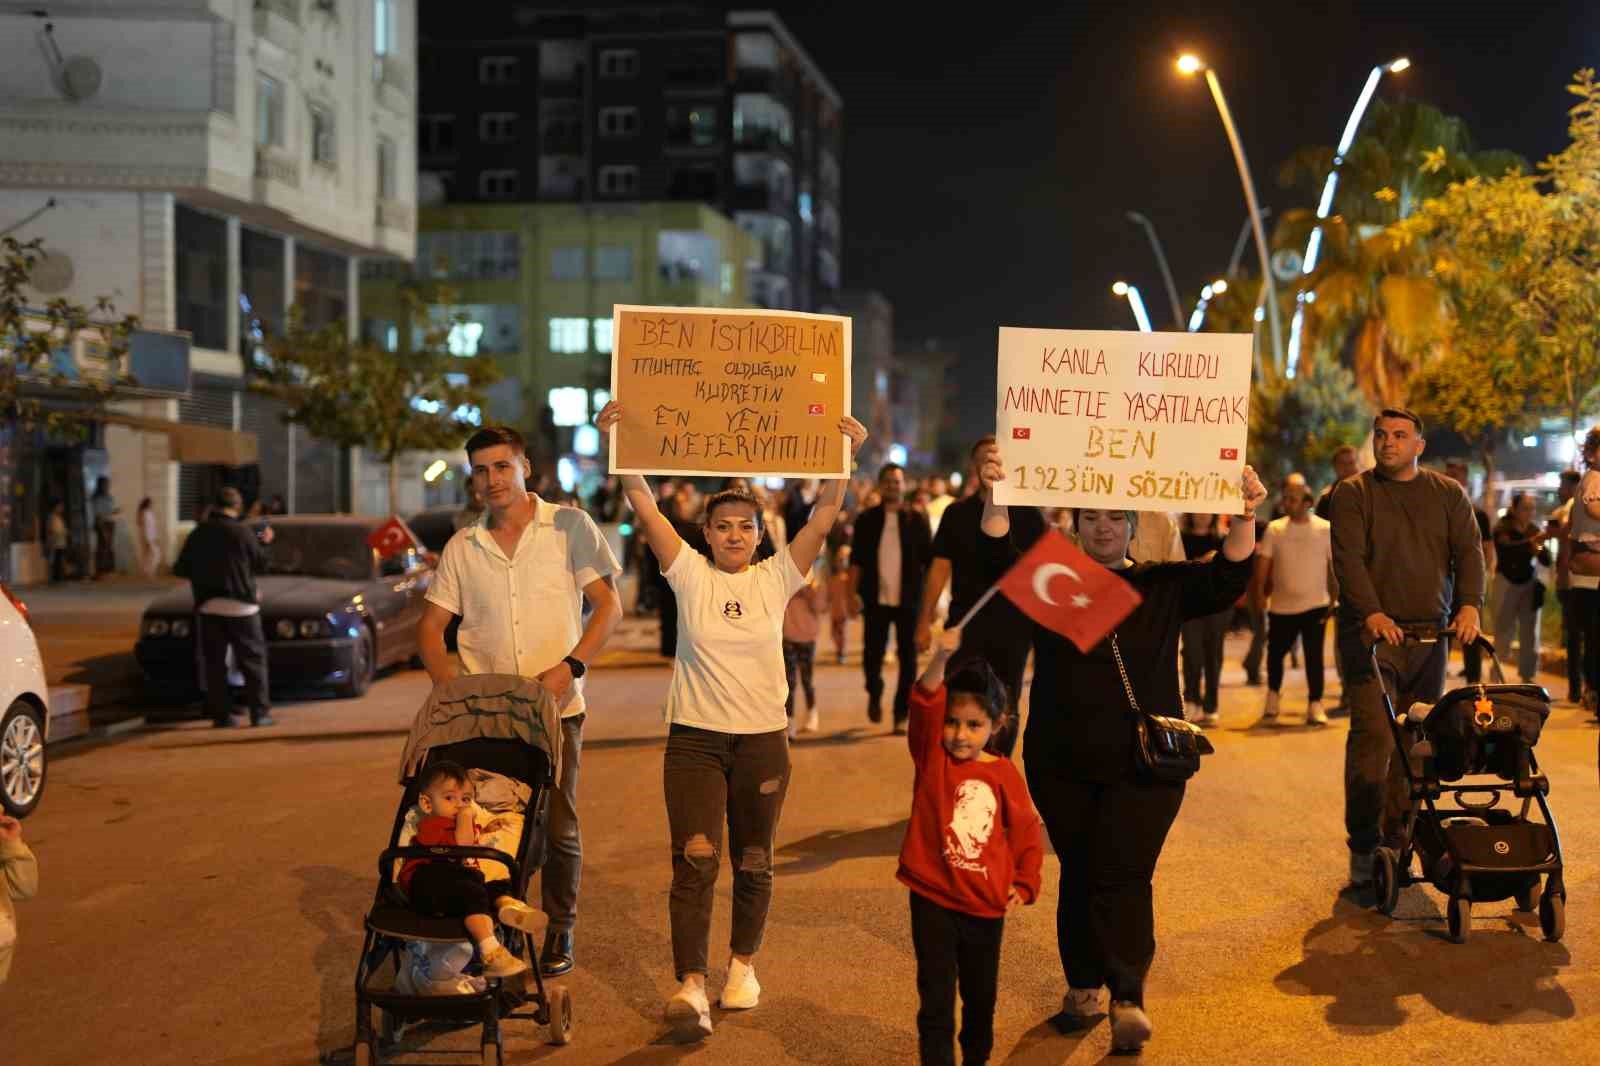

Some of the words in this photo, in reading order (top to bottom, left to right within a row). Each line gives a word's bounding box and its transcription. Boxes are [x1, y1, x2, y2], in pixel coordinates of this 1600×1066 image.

[1041, 347, 1108, 376] KANLA
[1138, 351, 1220, 379] KURULDU
[653, 404, 690, 426] EN
[726, 408, 779, 433] YENİ
[1084, 426, 1157, 459] BEN
